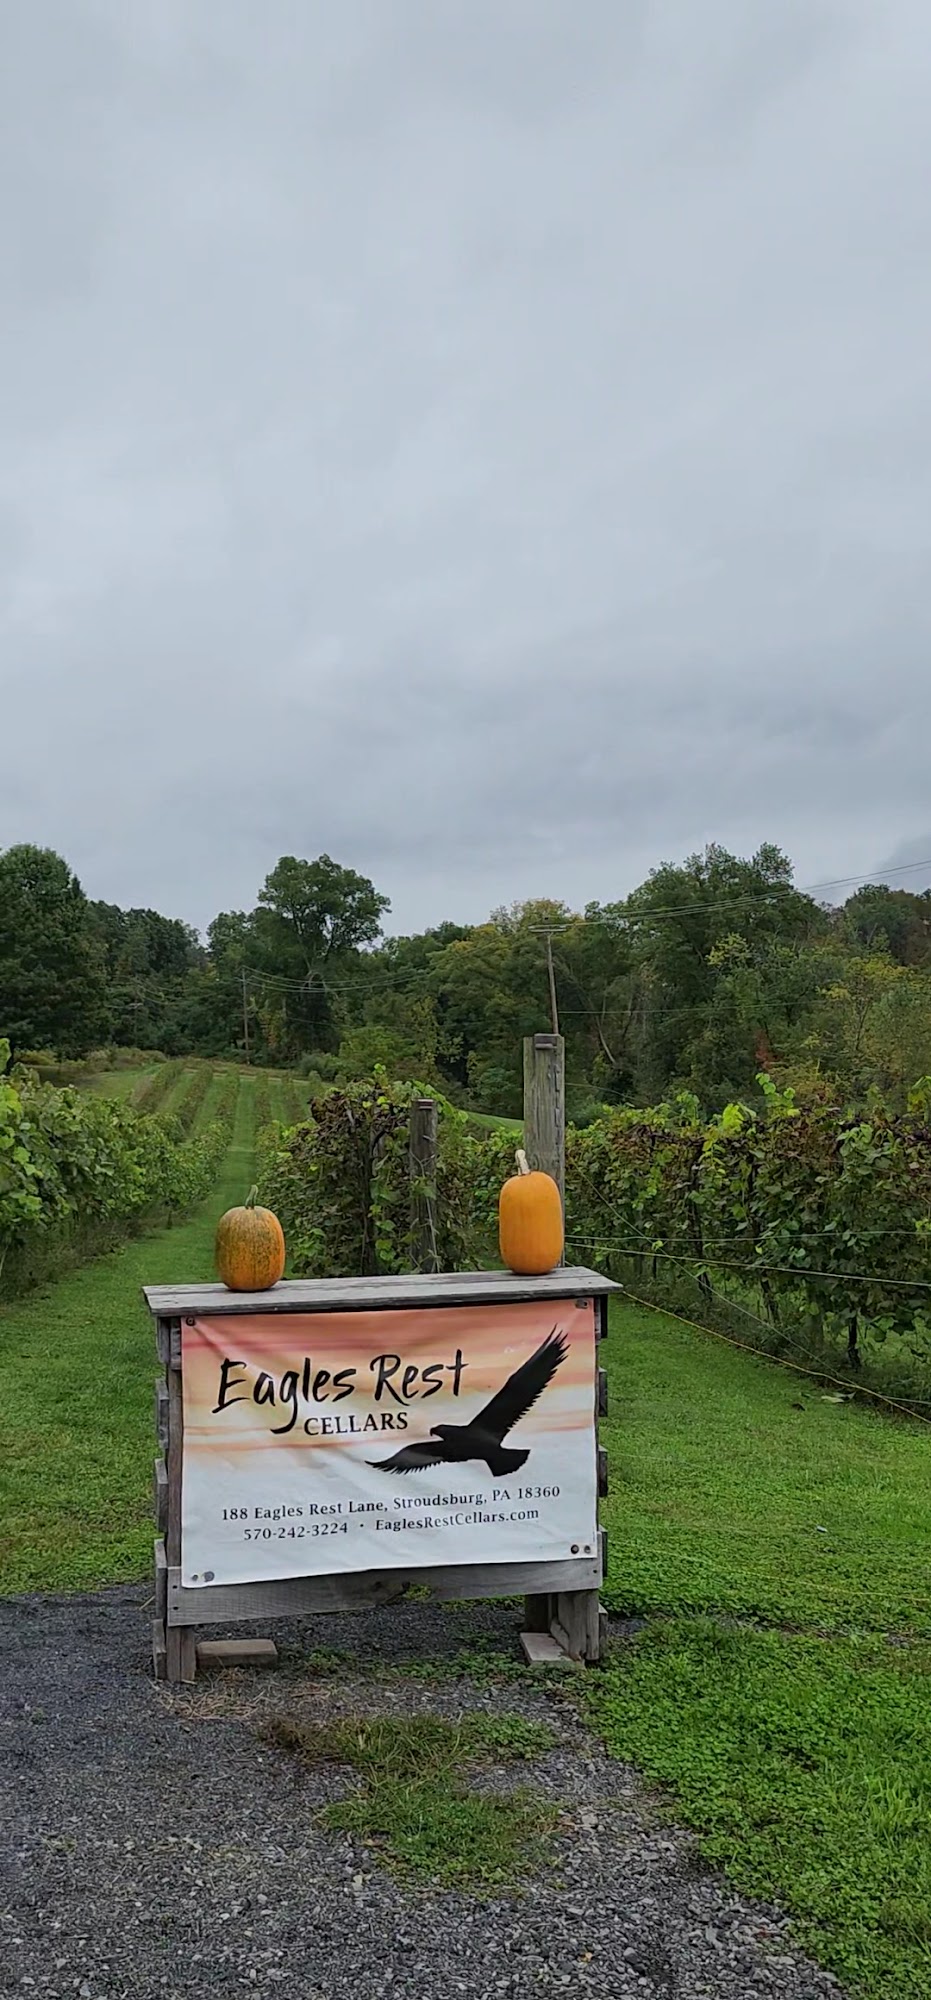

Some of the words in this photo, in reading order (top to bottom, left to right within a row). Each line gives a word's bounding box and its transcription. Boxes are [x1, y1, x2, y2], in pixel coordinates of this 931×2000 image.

[211, 1357, 357, 1434] Eagles
[369, 1349, 469, 1406] Rest
[303, 1411, 409, 1436] CELLARS
[222, 1507, 248, 1521] 188
[254, 1505, 303, 1521] Eagles
[309, 1502, 342, 1515] Rest
[348, 1500, 388, 1513] Lane,
[393, 1493, 487, 1510] Stroudsburg,
[492, 1489, 511, 1501] PA
[517, 1485, 561, 1500] 18360
[243, 1522, 349, 1541] 570-242-3224
[375, 1509, 539, 1532] EaglesRestCellars.com
